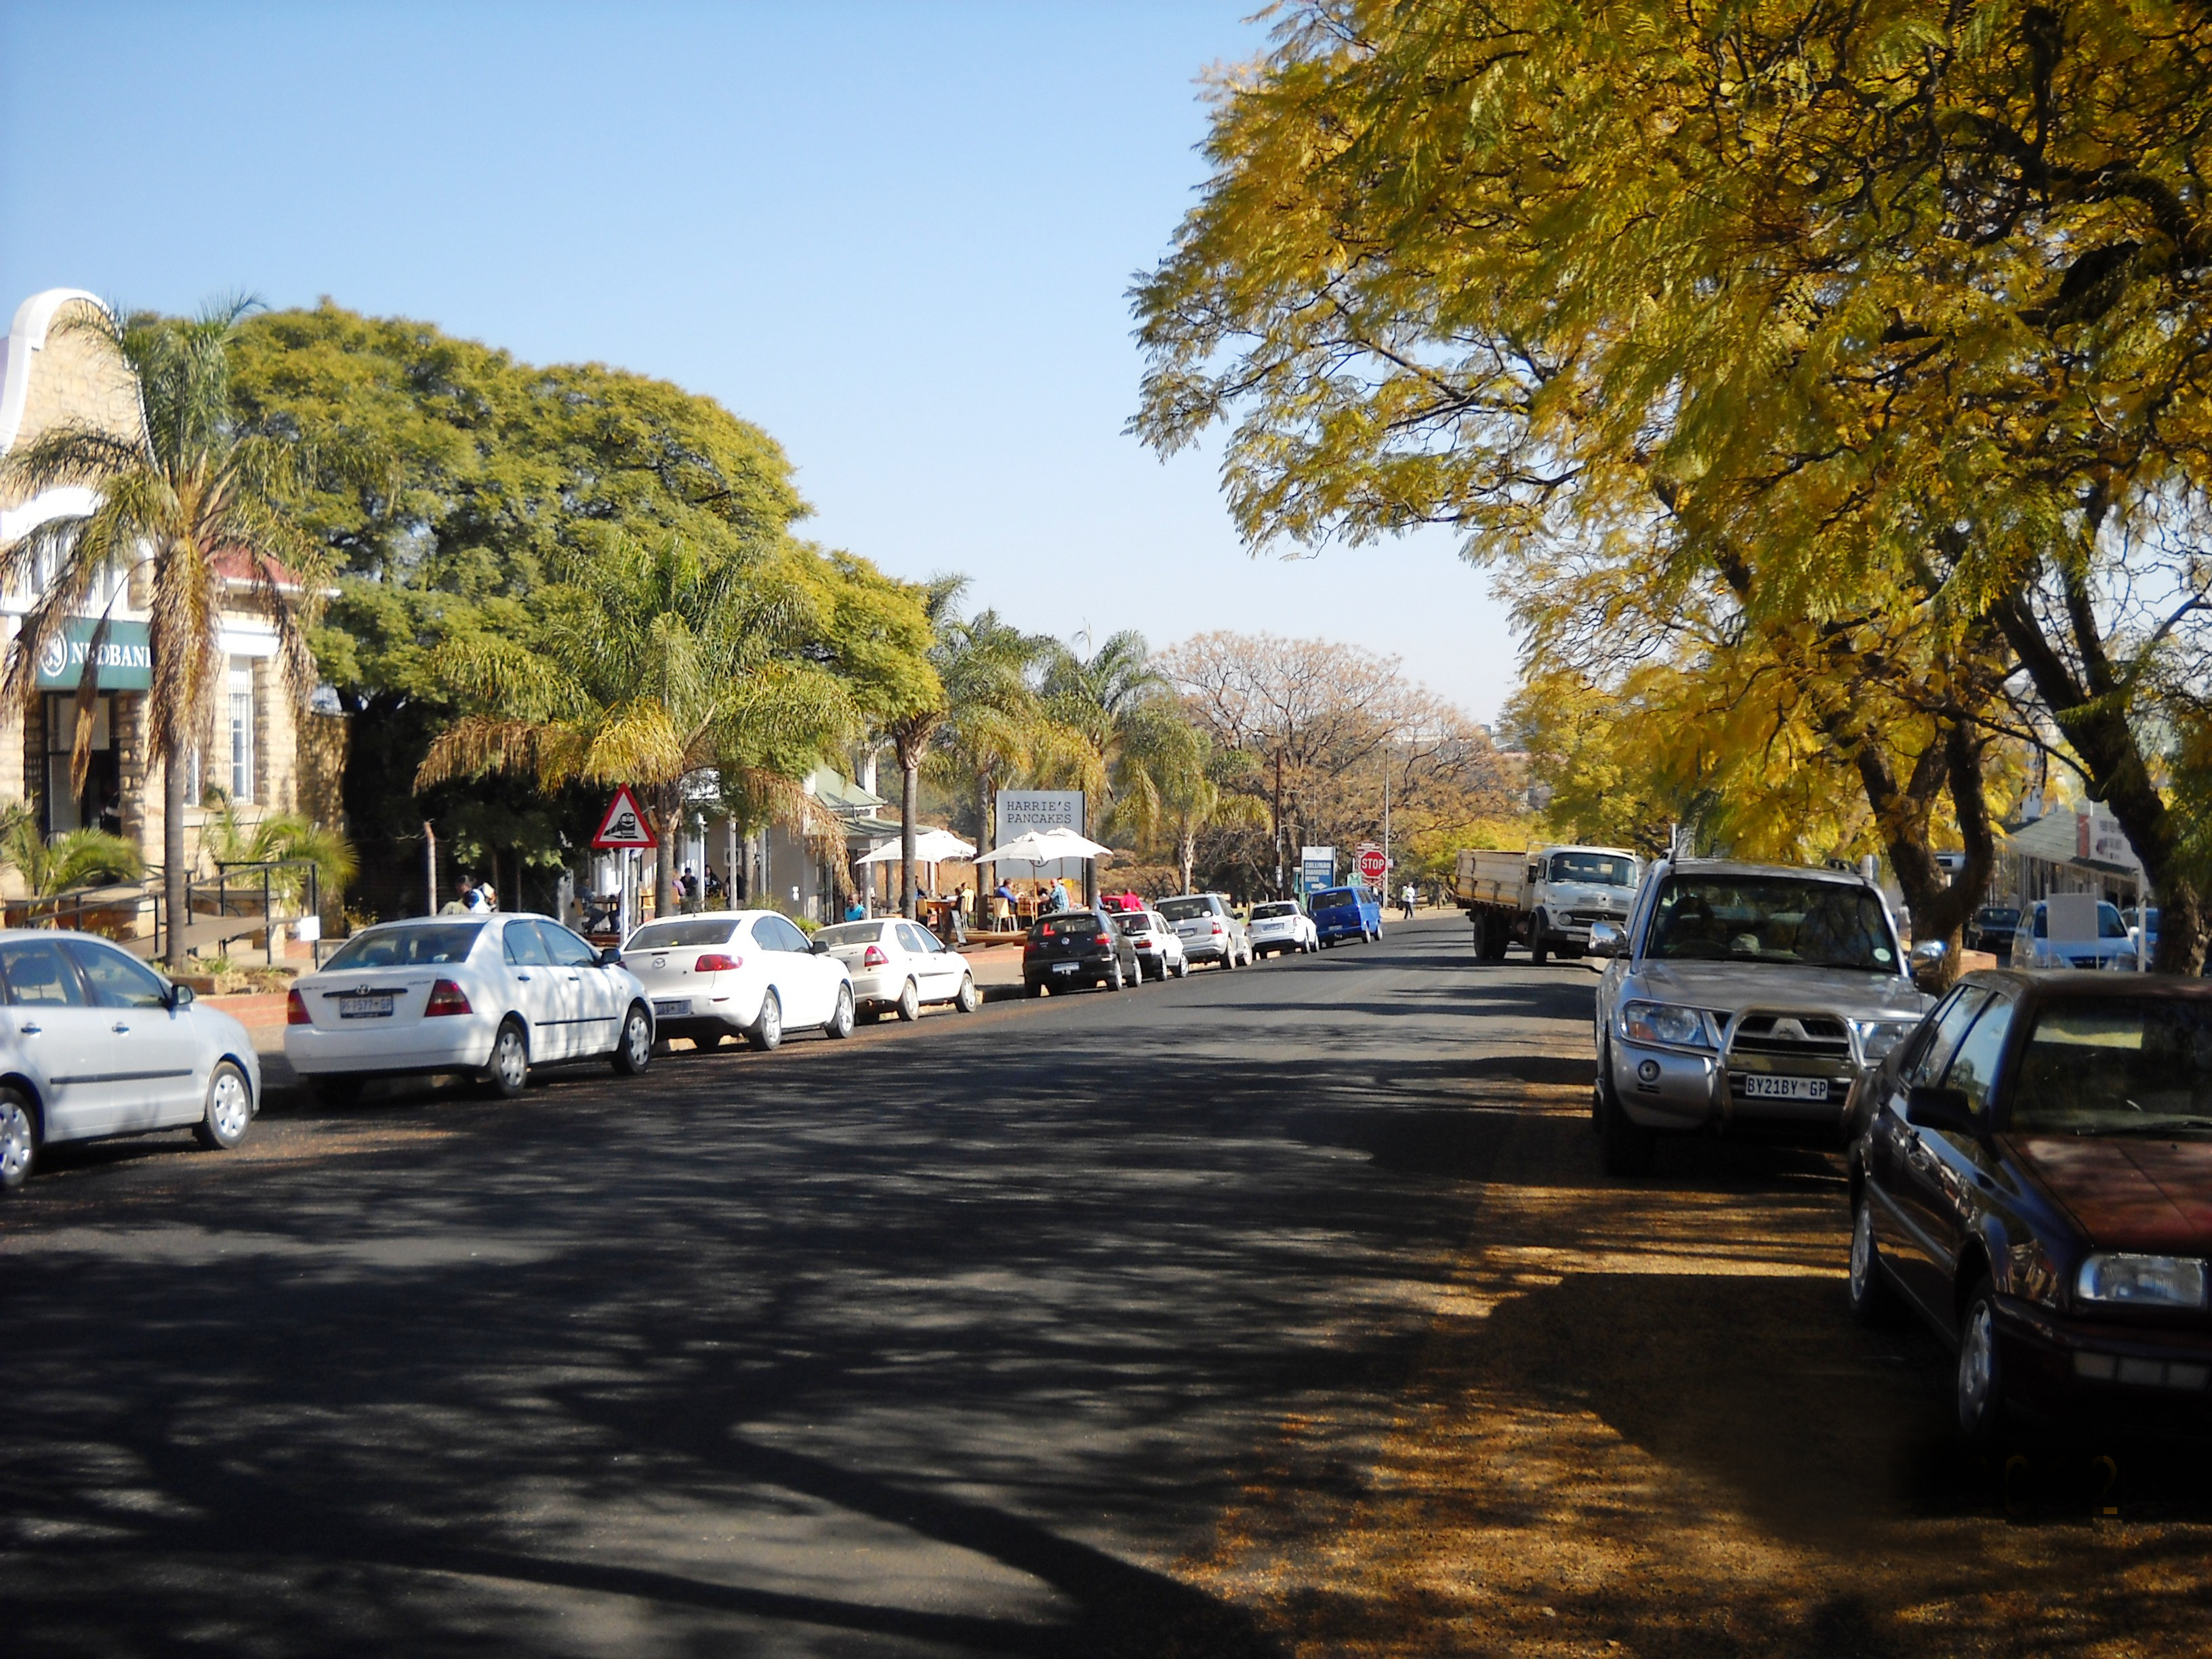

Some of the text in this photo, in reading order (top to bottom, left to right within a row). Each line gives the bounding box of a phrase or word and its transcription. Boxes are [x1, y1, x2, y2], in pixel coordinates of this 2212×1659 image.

[1006, 801, 1071, 812] HARRIE'S
[1007, 813, 1072, 824] PANCAKES
[1361, 858, 1385, 870] STOP
[1747, 1077, 1827, 1097] BY21BY GP
